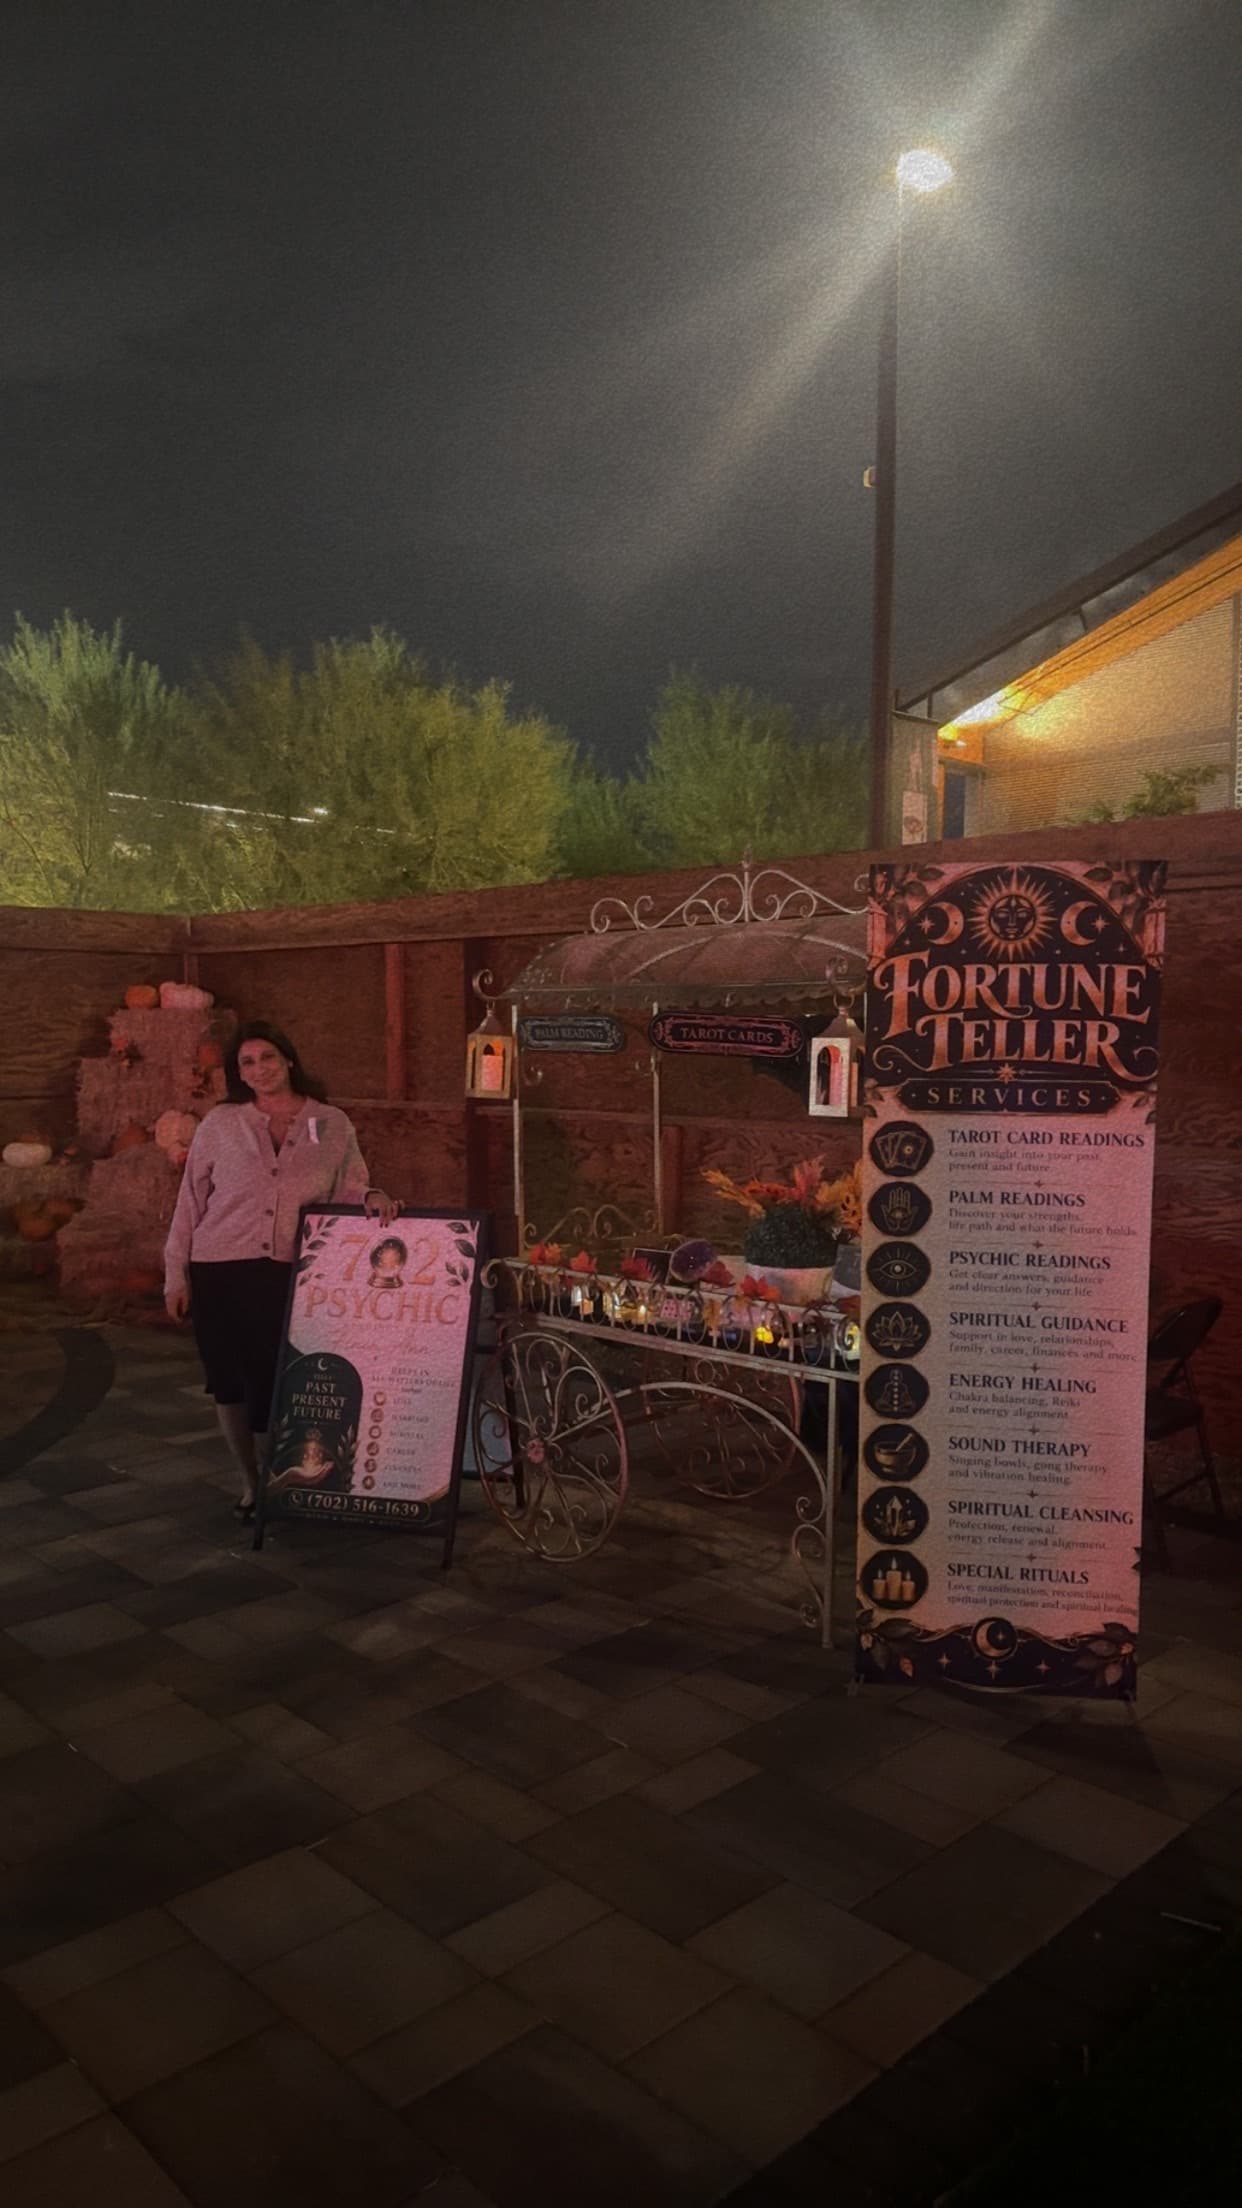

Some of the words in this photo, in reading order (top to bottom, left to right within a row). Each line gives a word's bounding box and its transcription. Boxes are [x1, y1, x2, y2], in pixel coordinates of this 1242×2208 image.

[873, 950, 1150, 1040] FORTUNE
[680, 1026, 726, 1040] TAROT
[727, 1028, 775, 1043] CARDS
[916, 1012, 1155, 1080] TELLER
[927, 1087, 1091, 1107] SERVICES
[948, 1129, 1001, 1145] TAROT
[1007, 1130, 1053, 1146] CARD
[1060, 1132, 1145, 1149] READINGS
[948, 1149, 976, 1159] Gain
[978, 1149, 1018, 1161] insight
[1021, 1150, 1045, 1160] into
[1047, 1152, 1073, 1163] your
[948, 1162, 989, 1173] present
[992, 1161, 1013, 1172] and
[949, 1190, 994, 1206] PALM
[1000, 1192, 1086, 1208] READINGS
[949, 1208, 995, 1220] Discover
[1000, 1211, 1026, 1222] your
[948, 1221, 965, 1232] life
[968, 1222, 992, 1235] path
[996, 1223, 1016, 1233] and
[1020, 1222, 1045, 1234] what
[1049, 1223, 1067, 1234] the
[1069, 1224, 1103, 1236] future
[949, 1251, 1020, 1267] PSYCHIC
[1026, 1253, 1111, 1270] READINGS
[949, 1270, 968, 1281] Get
[971, 1270, 999, 1281] clear
[1053, 1273, 1104, 1286] guidance
[948, 1281, 969, 1292] and
[972, 1282, 1022, 1294] direction
[1025, 1284, 1042, 1295] for
[1044, 1286, 1072, 1298] your
[303, 1284, 461, 1325] PSYCHIC
[949, 1312, 1036, 1329] SPIRITUAL
[1041, 1315, 1129, 1334] GUIDANCE
[949, 1330, 993, 1343] Support
[996, 1332, 1008, 1342] in
[1032, 1346, 1079, 1359] finances
[1082, 1349, 1104, 1360] and
[305, 1381, 337, 1394] PAST
[949, 1373, 1016, 1390] ENERGY
[1022, 1377, 1097, 1394] HEALING
[291, 1392, 348, 1408] PRESENT
[949, 1391, 989, 1404] Chakra
[1052, 1396, 1081, 1408] Reiki
[292, 1405, 343, 1421] FUTURE
[949, 1404, 970, 1415] and
[972, 1407, 1009, 1419] energy
[948, 1436, 1007, 1453] SOUND
[1011, 1440, 1092, 1458] THERAPY
[948, 1455, 992, 1469] Singing
[1033, 1461, 1061, 1474] gong
[948, 1468, 970, 1479] and
[973, 1469, 1024, 1482] vibration
[307, 1493, 348, 1511] (702)
[351, 1500, 420, 1518] 516-1639
[948, 1500, 1034, 1519] SPIRITUAL
[1039, 1506, 1134, 1526] CLEANSING
[947, 1534, 983, 1546] energy
[987, 1533, 1025, 1545] release
[1027, 1536, 1048, 1547] and
[947, 1562, 1014, 1580] SPECIAL
[1019, 1566, 1089, 1585] RITUALS
[947, 1594, 987, 1607] spiritual
[989, 1596, 1039, 1609] protection
[1041, 1599, 1060, 1610] and
